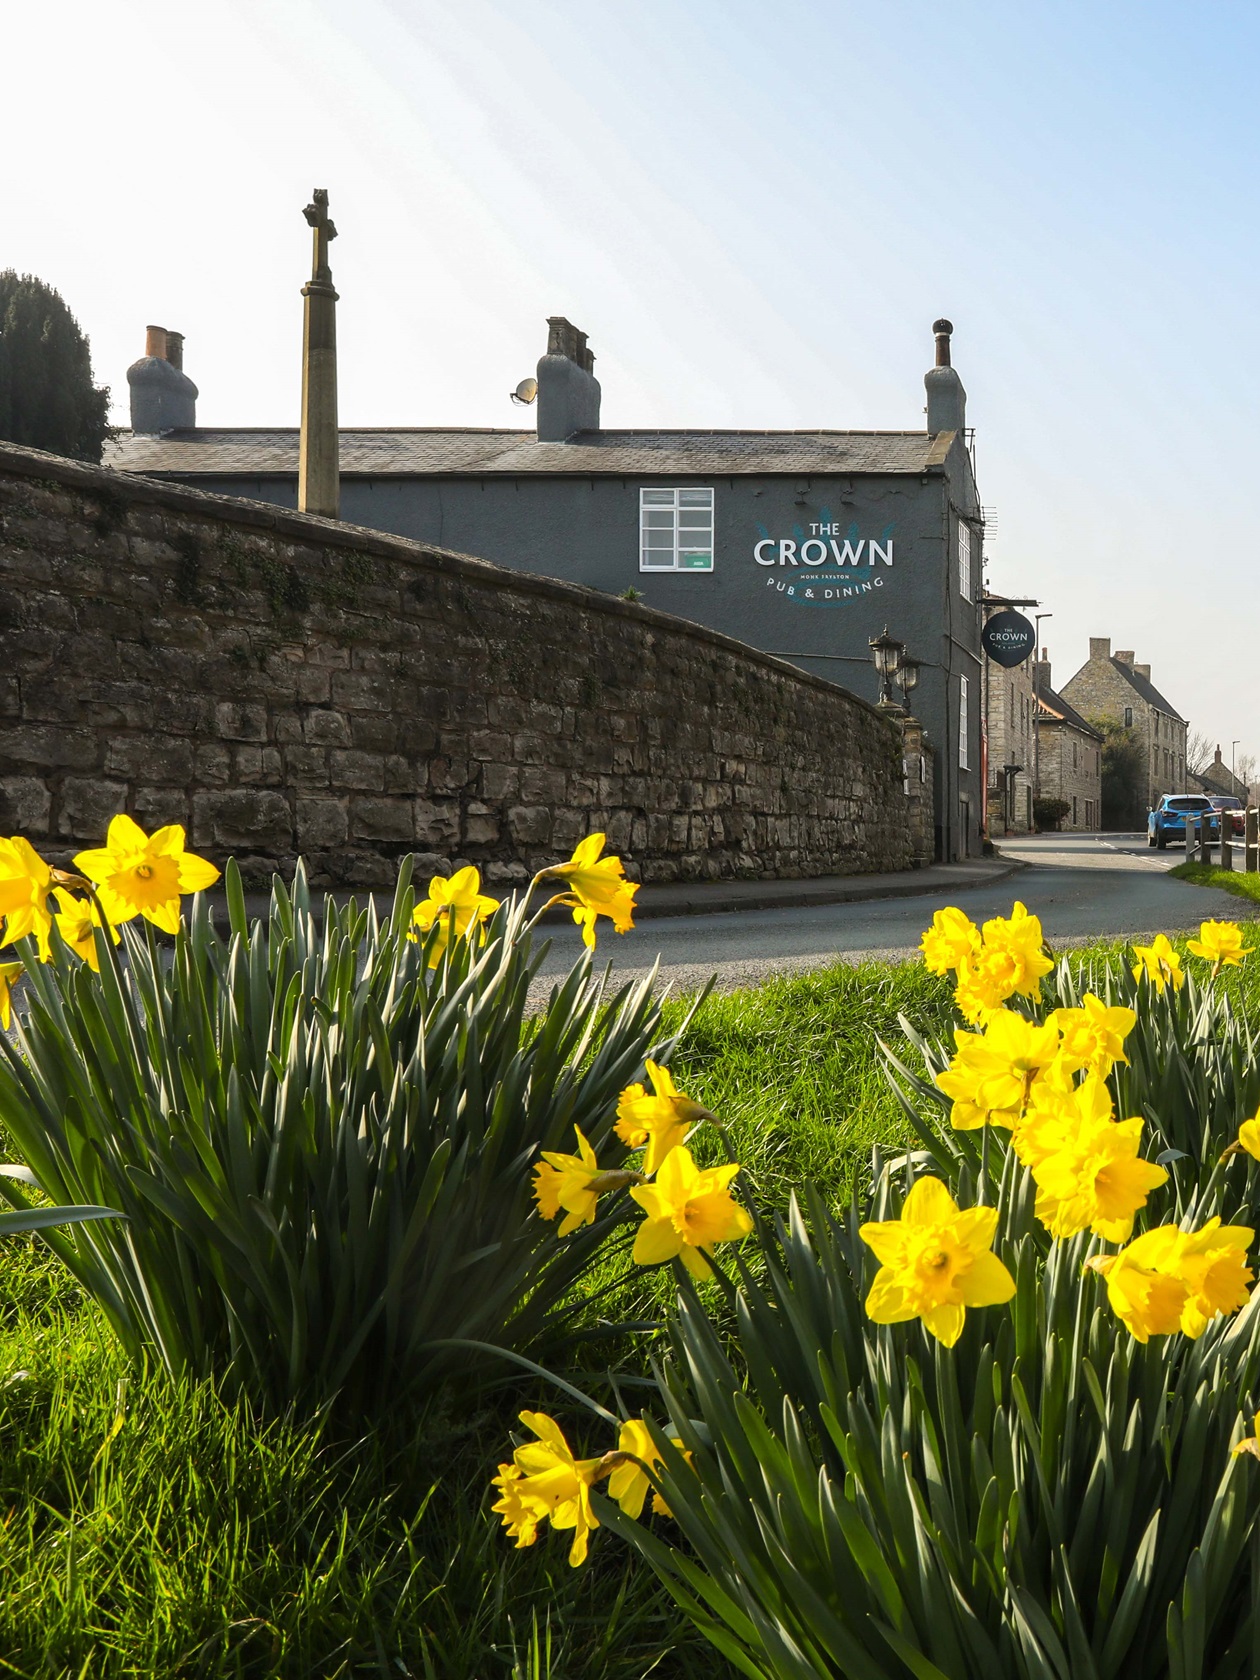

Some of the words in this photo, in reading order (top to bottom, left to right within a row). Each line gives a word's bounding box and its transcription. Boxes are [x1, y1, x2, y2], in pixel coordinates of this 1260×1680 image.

[809, 523, 840, 536] THE
[753, 539, 894, 566] CROWN
[766, 577, 795, 596] PUB
[804, 588, 815, 599] &
[824, 576, 884, 599] DINING
[990, 632, 1028, 640] CROWN
